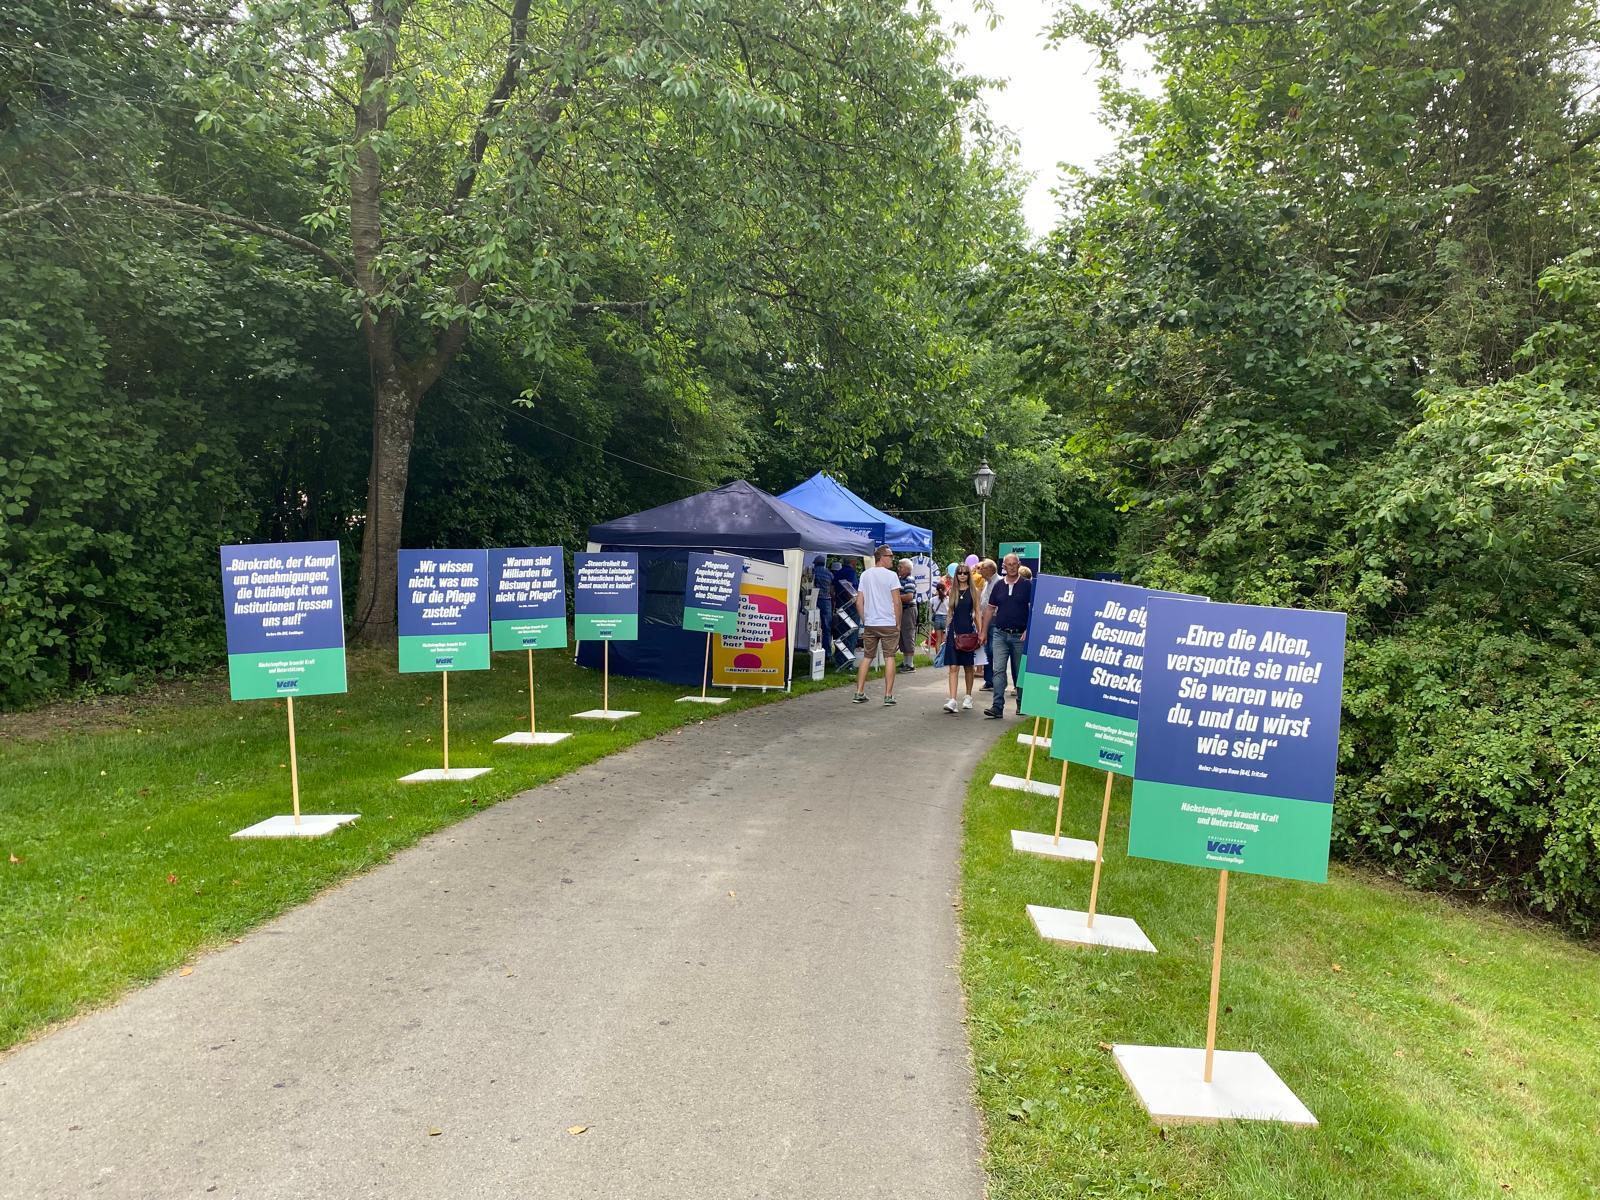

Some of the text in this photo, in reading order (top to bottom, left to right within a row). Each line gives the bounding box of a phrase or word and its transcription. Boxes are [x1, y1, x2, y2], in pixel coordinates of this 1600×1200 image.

[226, 555, 336, 571] „Bürokratie, der Kampf
[414, 561, 473, 573] „Wir wissen
[503, 556, 551, 567] „Warum sind
[234, 571, 329, 585] um Genehmigungen,
[503, 567, 552, 578] Milliarden für
[695, 568, 723, 577] Angehörige
[408, 576, 479, 588] nicht, was uns
[499, 578, 557, 590] Rüstung da und
[237, 584, 328, 599] die Unfähigkeit von
[412, 590, 476, 604] für die Pflege
[495, 592, 515, 602] nicht
[517, 591, 527, 601] für
[234, 598, 333, 614] Institutionen fressen
[1095, 600, 1147, 626] „Die eig
[263, 617, 280, 627] uns
[722, 634, 768, 642] gearbeitet
[1048, 634, 1066, 645] ane
[1091, 621, 1146, 648] Gesund
[1176, 624, 1311, 657] „Ehre die Alten,
[1080, 643, 1122, 666] bleibt
[1167, 653, 1322, 684] verspotte sie nie!
[1178, 677, 1303, 709] Sie waren wie
[1167, 703, 1311, 738] du, und du wirst
[1197, 734, 1278, 760] wie sie!“
[1099, 750, 1123, 762] VdK
[1181, 802, 1279, 823] Nächstenpflege braucht Kraft
[1211, 818, 1260, 832] Unterstützung.
[1207, 841, 1245, 855] VdK
